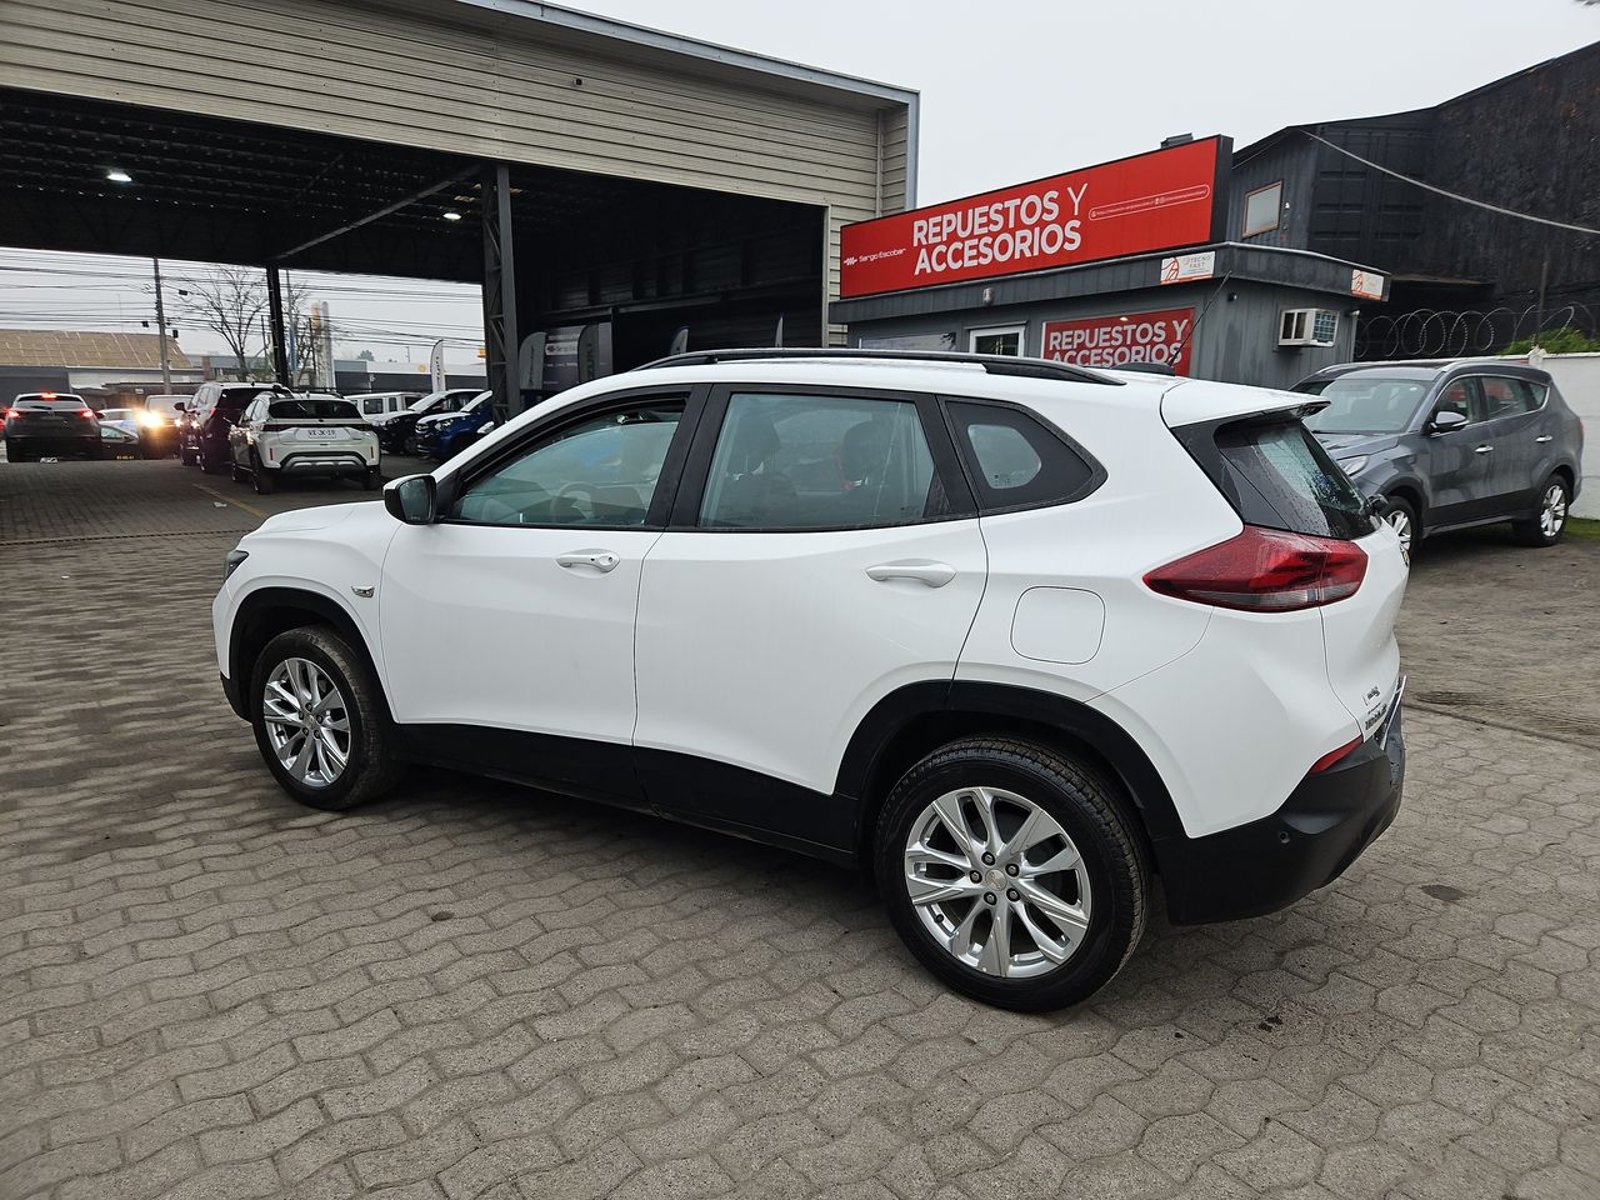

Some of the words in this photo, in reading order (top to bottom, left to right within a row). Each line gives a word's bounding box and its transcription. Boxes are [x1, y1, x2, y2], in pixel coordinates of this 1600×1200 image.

[913, 190, 1060, 247] REPUESTOS
[1066, 182, 1088, 216] Y
[914, 219, 1082, 276] ACCESORIOS
[1049, 321, 1167, 351] REPUESTOS
[1172, 319, 1189, 341] Y
